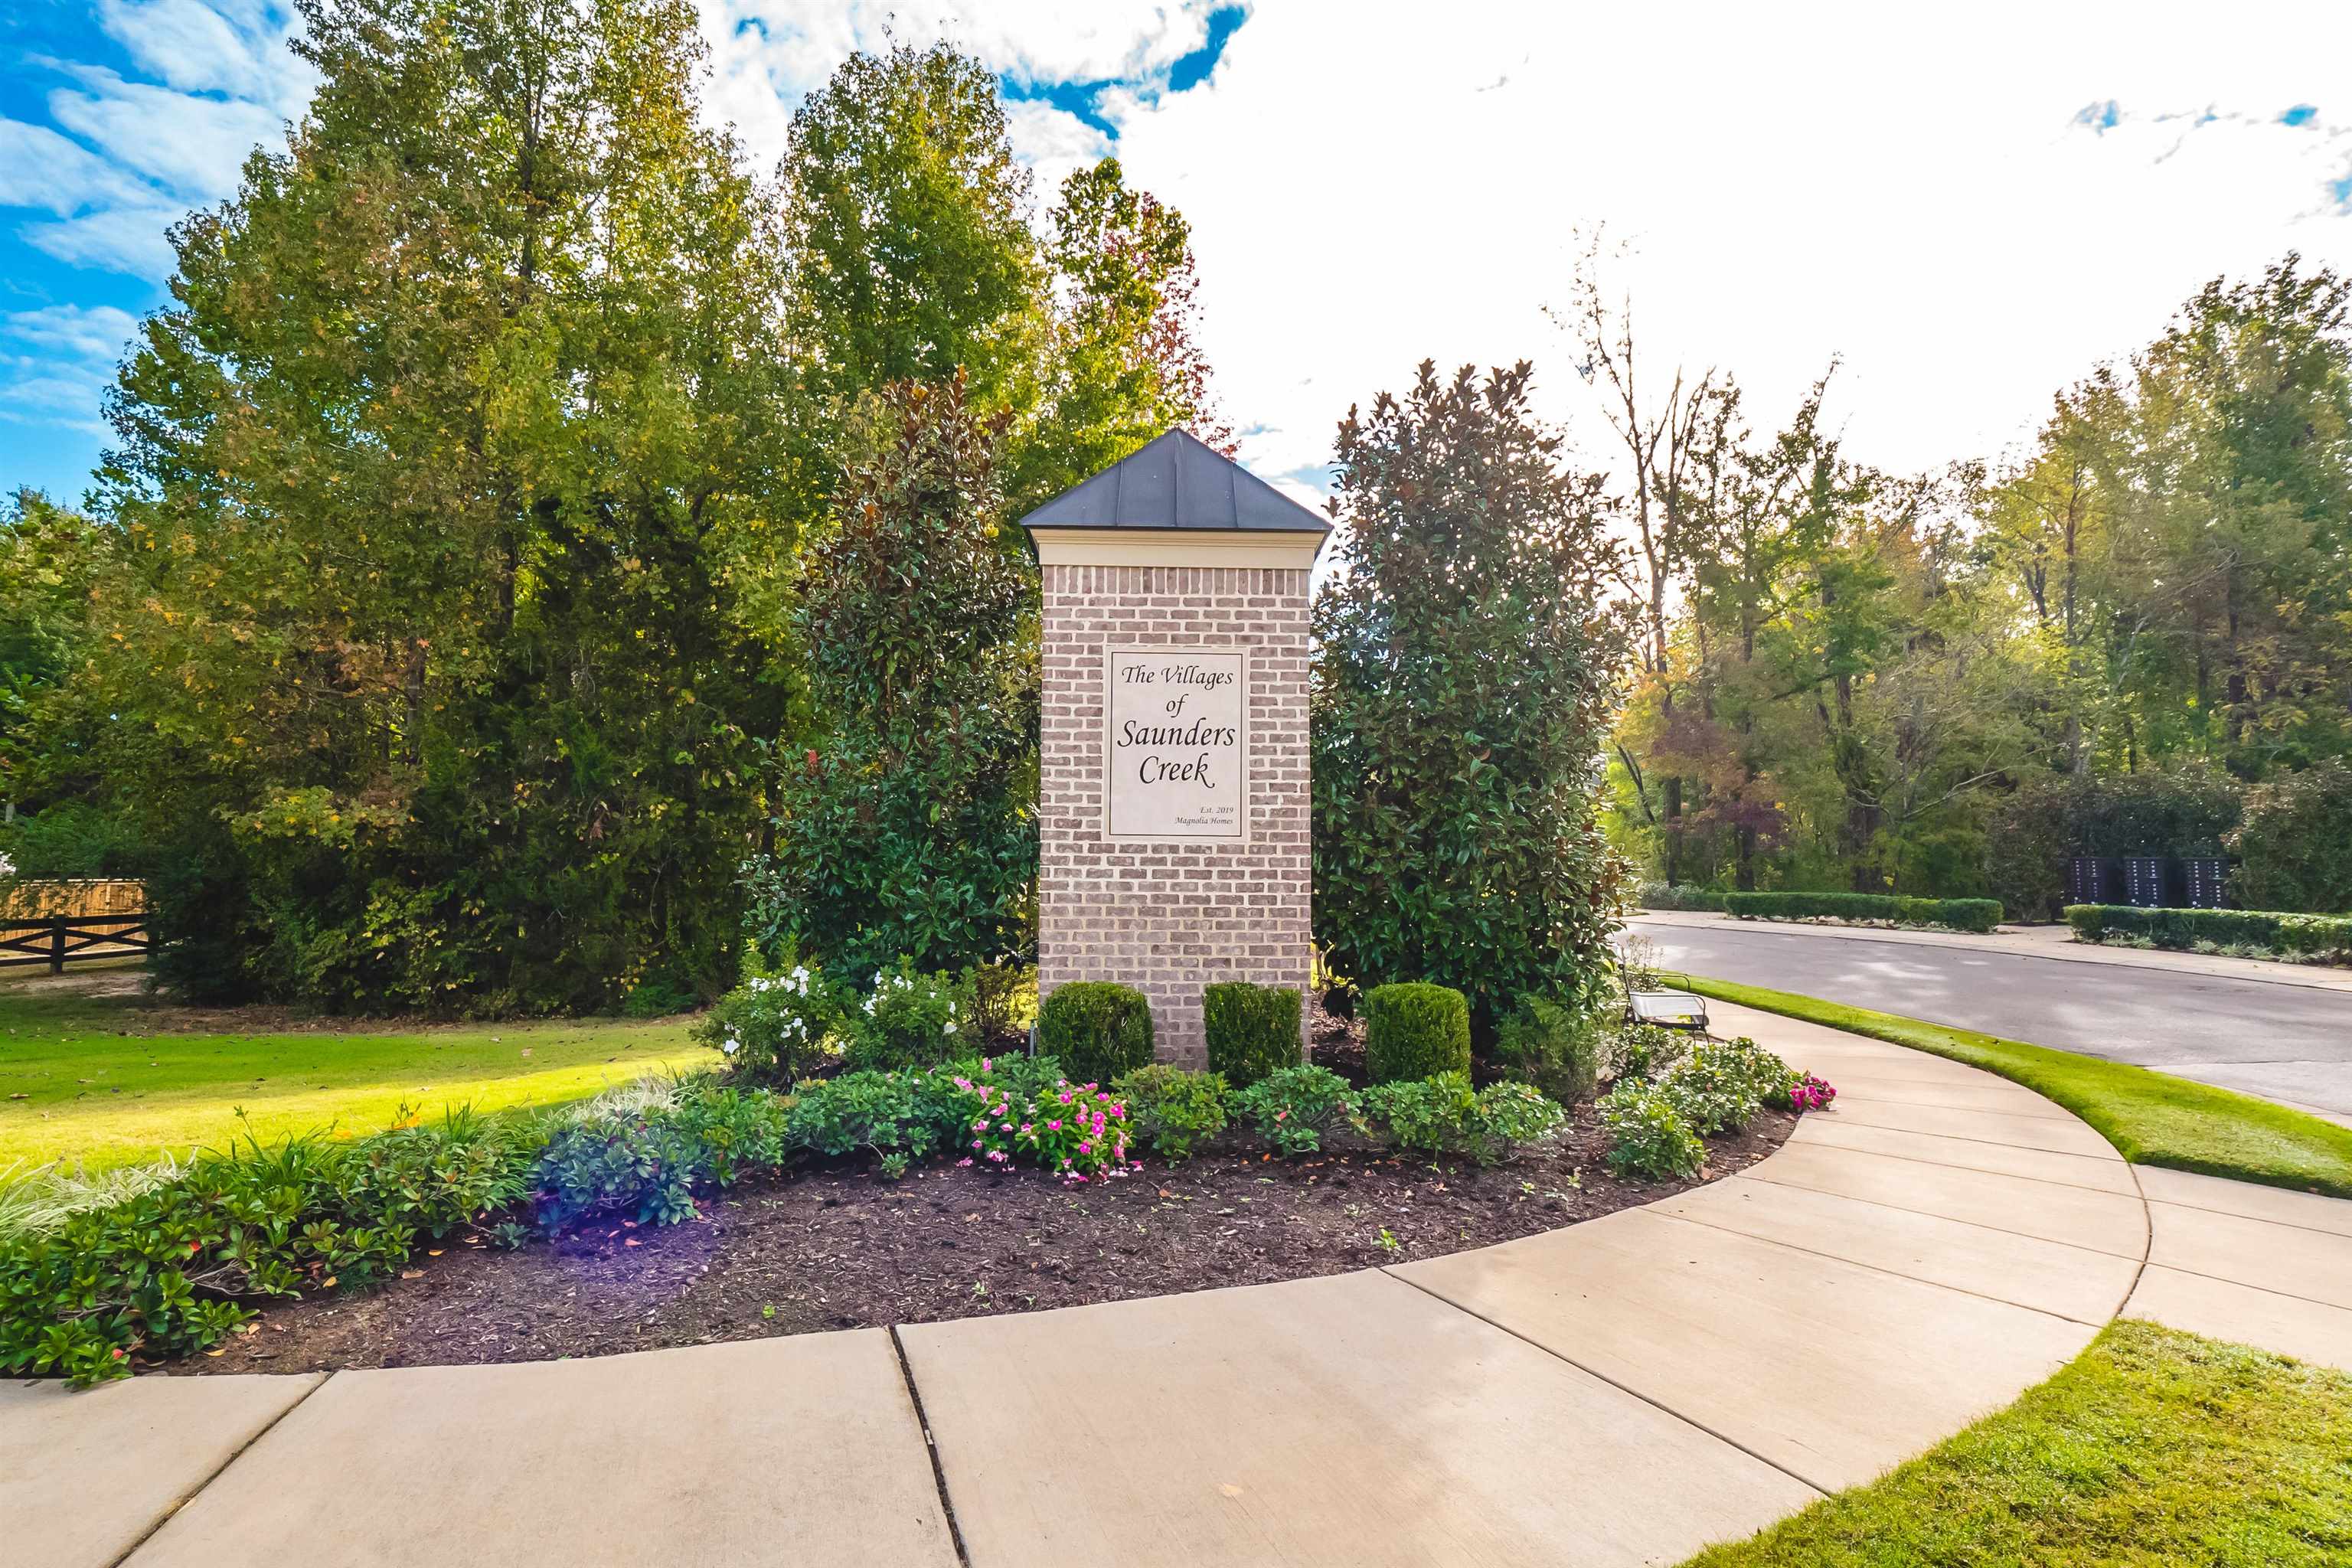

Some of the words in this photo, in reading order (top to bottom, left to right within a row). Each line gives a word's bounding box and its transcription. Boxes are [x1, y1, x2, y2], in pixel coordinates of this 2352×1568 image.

[1121, 664, 1155, 684] The
[1160, 665, 1233, 691] Villages
[1165, 694, 1189, 718] of
[1116, 717, 1236, 747] Saunders
[1139, 752, 1216, 789] Creek
[1175, 816, 1208, 826] Magnolia
[1210, 816, 1233, 825] Homes
